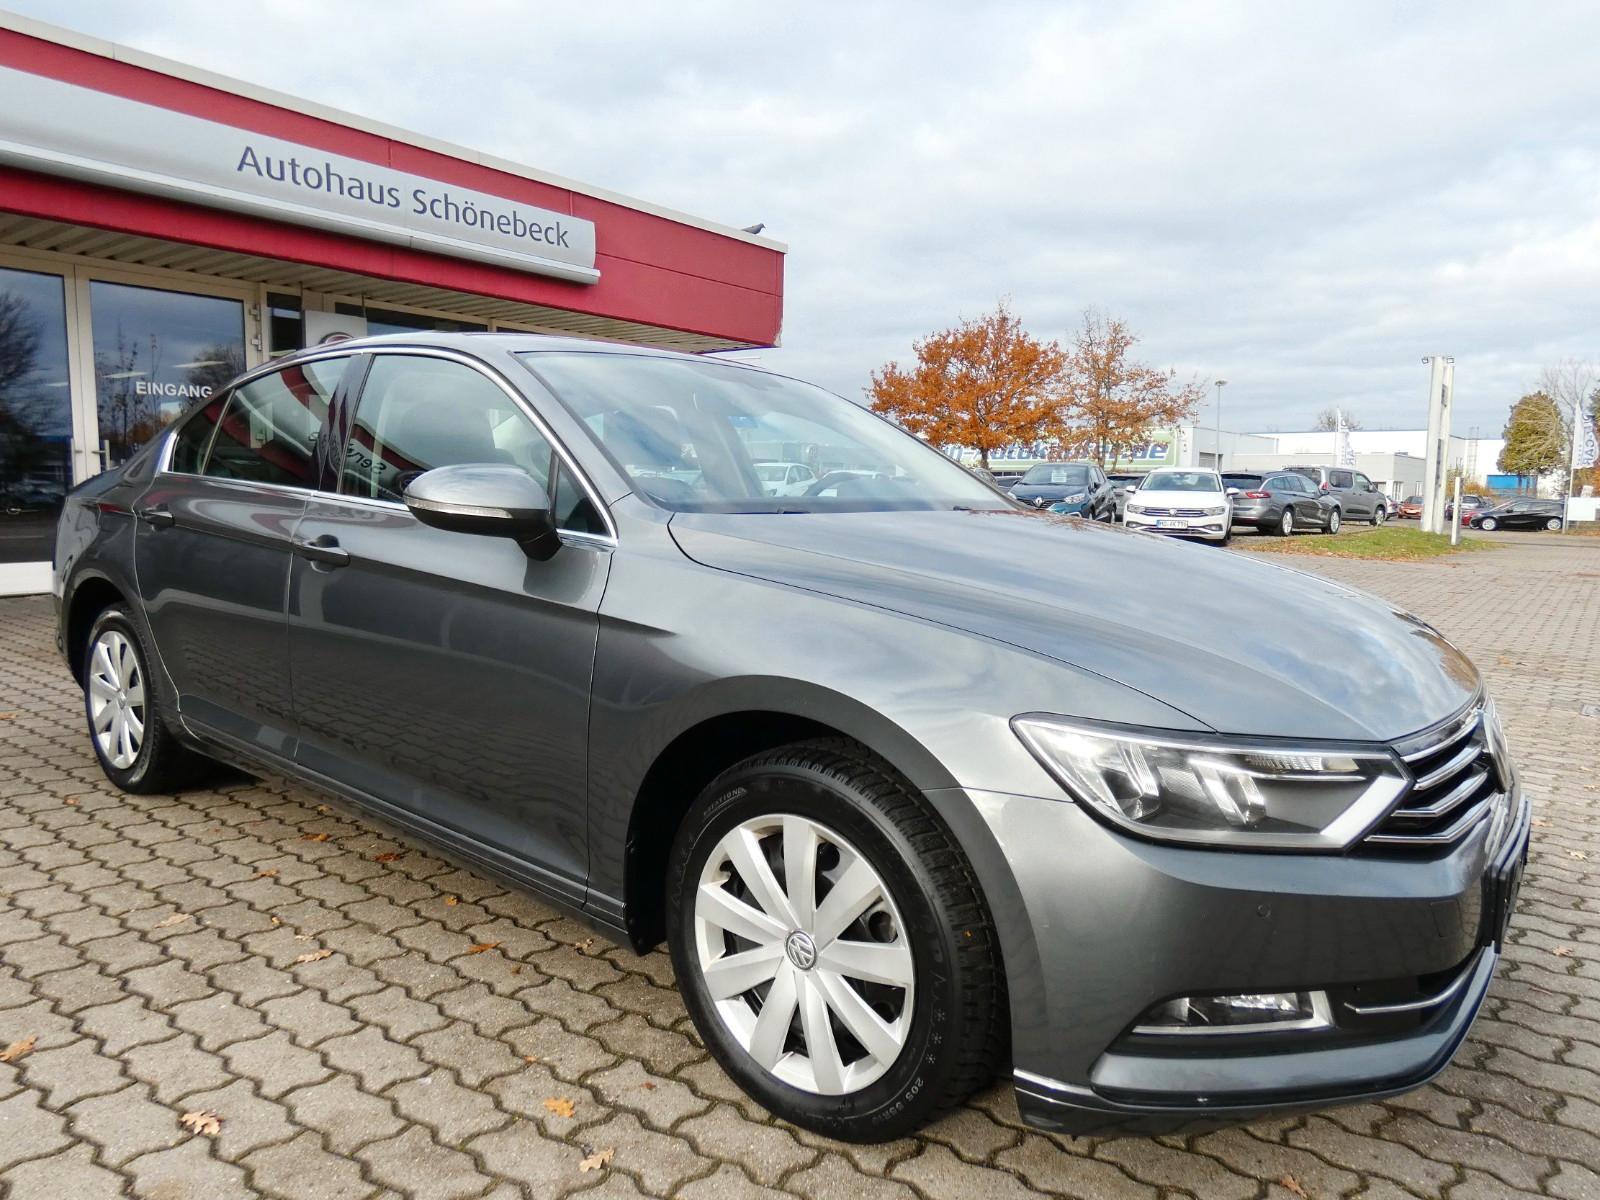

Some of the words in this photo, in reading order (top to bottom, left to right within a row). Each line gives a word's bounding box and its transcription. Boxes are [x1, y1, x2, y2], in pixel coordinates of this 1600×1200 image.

[237, 146, 401, 208] Autohaus
[412, 189, 570, 248] Schönebeck
[135, 381, 213, 399] EINGANG
